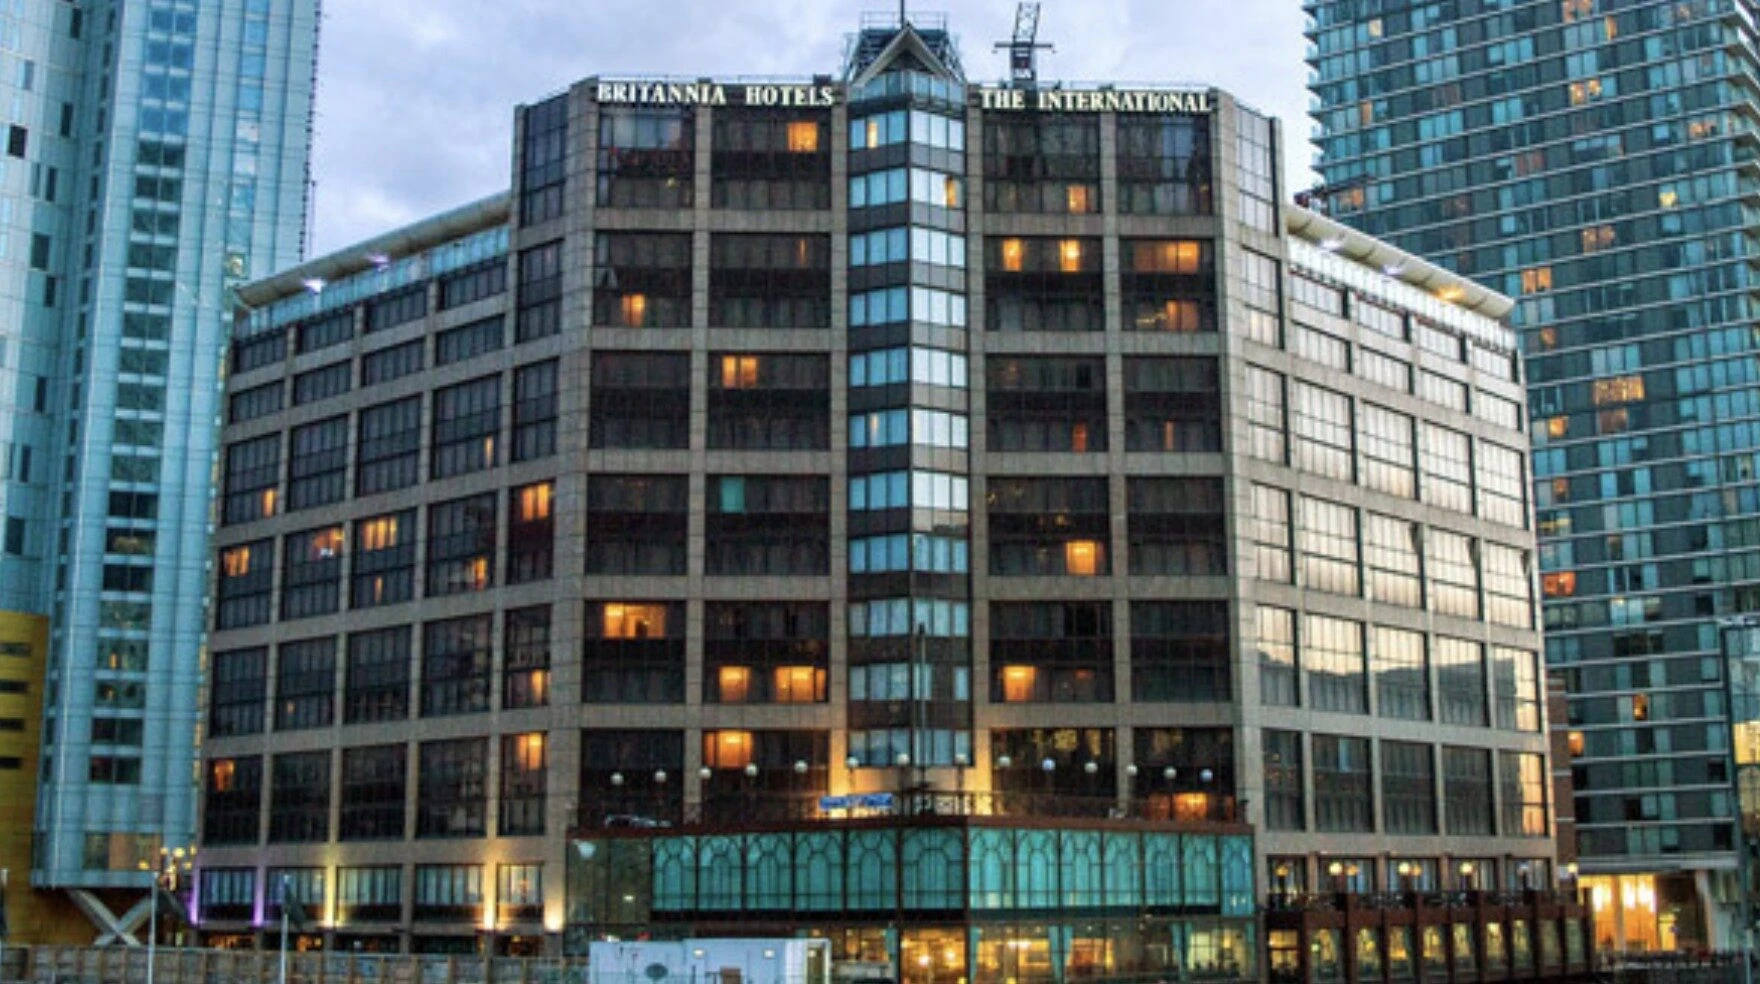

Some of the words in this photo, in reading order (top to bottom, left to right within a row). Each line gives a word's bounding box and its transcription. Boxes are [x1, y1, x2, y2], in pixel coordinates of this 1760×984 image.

[597, 83, 726, 104] BRITANNIA
[745, 86, 834, 106] HOTELS
[980, 90, 1025, 109] THE
[1038, 91, 1210, 112] INTERNATIONAL
